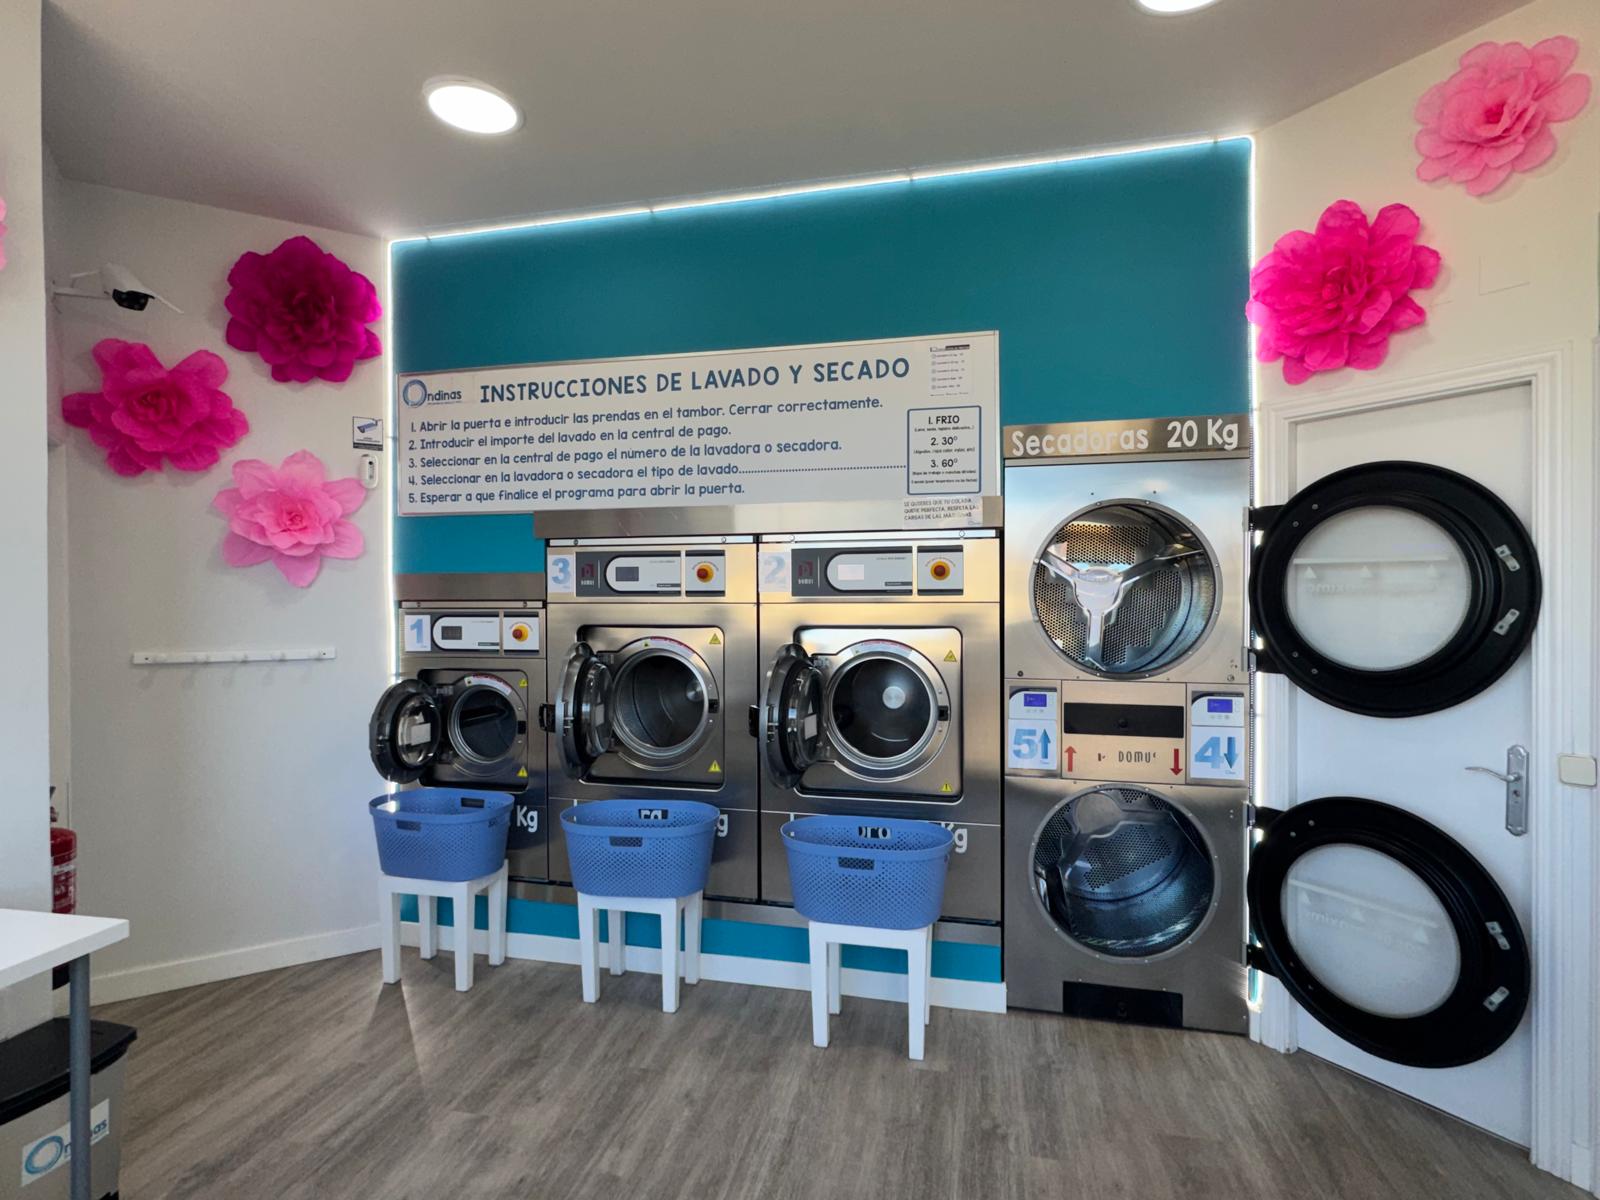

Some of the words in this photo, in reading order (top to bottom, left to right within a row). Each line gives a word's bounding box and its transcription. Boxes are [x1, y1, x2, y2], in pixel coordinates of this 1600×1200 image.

[403, 379, 462, 408] Ondinas
[480, 375, 647, 402] INSTRUCCIONES
[656, 372, 682, 392] DE
[691, 366, 780, 391] LAVADO
[789, 364, 803, 385] Y
[813, 357, 910, 383] SECADO
[411, 422, 417, 432] 1.
[419, 420, 448, 432] Abrir
[451, 419, 460, 430] la
[463, 418, 501, 432] puerta
[504, 419, 512, 427] e
[514, 414, 569, 426] introducir
[572, 412, 589, 424] las
[592, 410, 640, 425] prendas
[644, 410, 659, 420] en
[662, 407, 673, 419] el
[676, 405, 725, 418] tambor.
[729, 403, 773, 416] Cerrar
[777, 396, 883, 413] correctamente.
[936, 415, 960, 425] FRIO
[408, 440, 417, 450] 2.
[420, 436, 475, 450] Introducir
[478, 435, 488, 447] el
[490, 433, 535, 447] importe
[538, 432, 555, 443] del
[558, 431, 596, 443] lavado
[600, 431, 614, 441] en
[618, 429, 628, 440] la
[631, 426, 674, 440] central
[678, 425, 694, 437] de
[697, 426, 732, 439] pago.
[930, 437, 939, 446] 2.
[1011, 427, 1149, 457] Secadoras
[1167, 420, 1198, 448] 20
[1207, 418, 1238, 450] Kg
[408, 458, 417, 468] 3.
[420, 456, 481, 468] Seleccionar
[484, 455, 497, 465] en
[500, 453, 510, 464] la
[513, 451, 553, 463] central
[556, 450, 571, 461] de
[574, 451, 603, 463] pago
[607, 448, 617, 460] el
[620, 447, 667, 460] número
[670, 445, 686, 457] de
[690, 444, 700, 456] la
[704, 442, 761, 456] lavadora
[765, 445, 773, 454] o
[777, 439, 842, 453] secadora.
[930, 459, 939, 468] 3.
[408, 475, 418, 486] 4.
[420, 473, 481, 486] Seleccionar
[485, 473, 498, 483] en
[501, 471, 511, 482] la
[514, 469, 564, 482] lavadora
[567, 471, 574, 480] o
[577, 467, 634, 479] secadora
[637, 466, 648, 477] el
[651, 465, 674, 479] tipo
[678, 464, 694, 476] de
[408, 492, 418, 503] 5.
[420, 491, 462, 504] Esperar
[465, 493, 472, 501] a
[475, 491, 495, 503] que
[499, 488, 539, 501] finalice
[542, 487, 552, 499] el
[555, 487, 614, 500] programa
[617, 485, 646, 498] para
[650, 483, 681, 496] abrir
[684, 482, 695, 495] la
[698, 482, 745, 497] puerta.
[551, 557, 571, 585] 3
[764, 555, 786, 585] 2
[409, 618, 424, 644] 1
[1011, 728, 1037, 760] 5
[1194, 736, 1224, 769] 4
[516, 805, 538, 833] Kg
